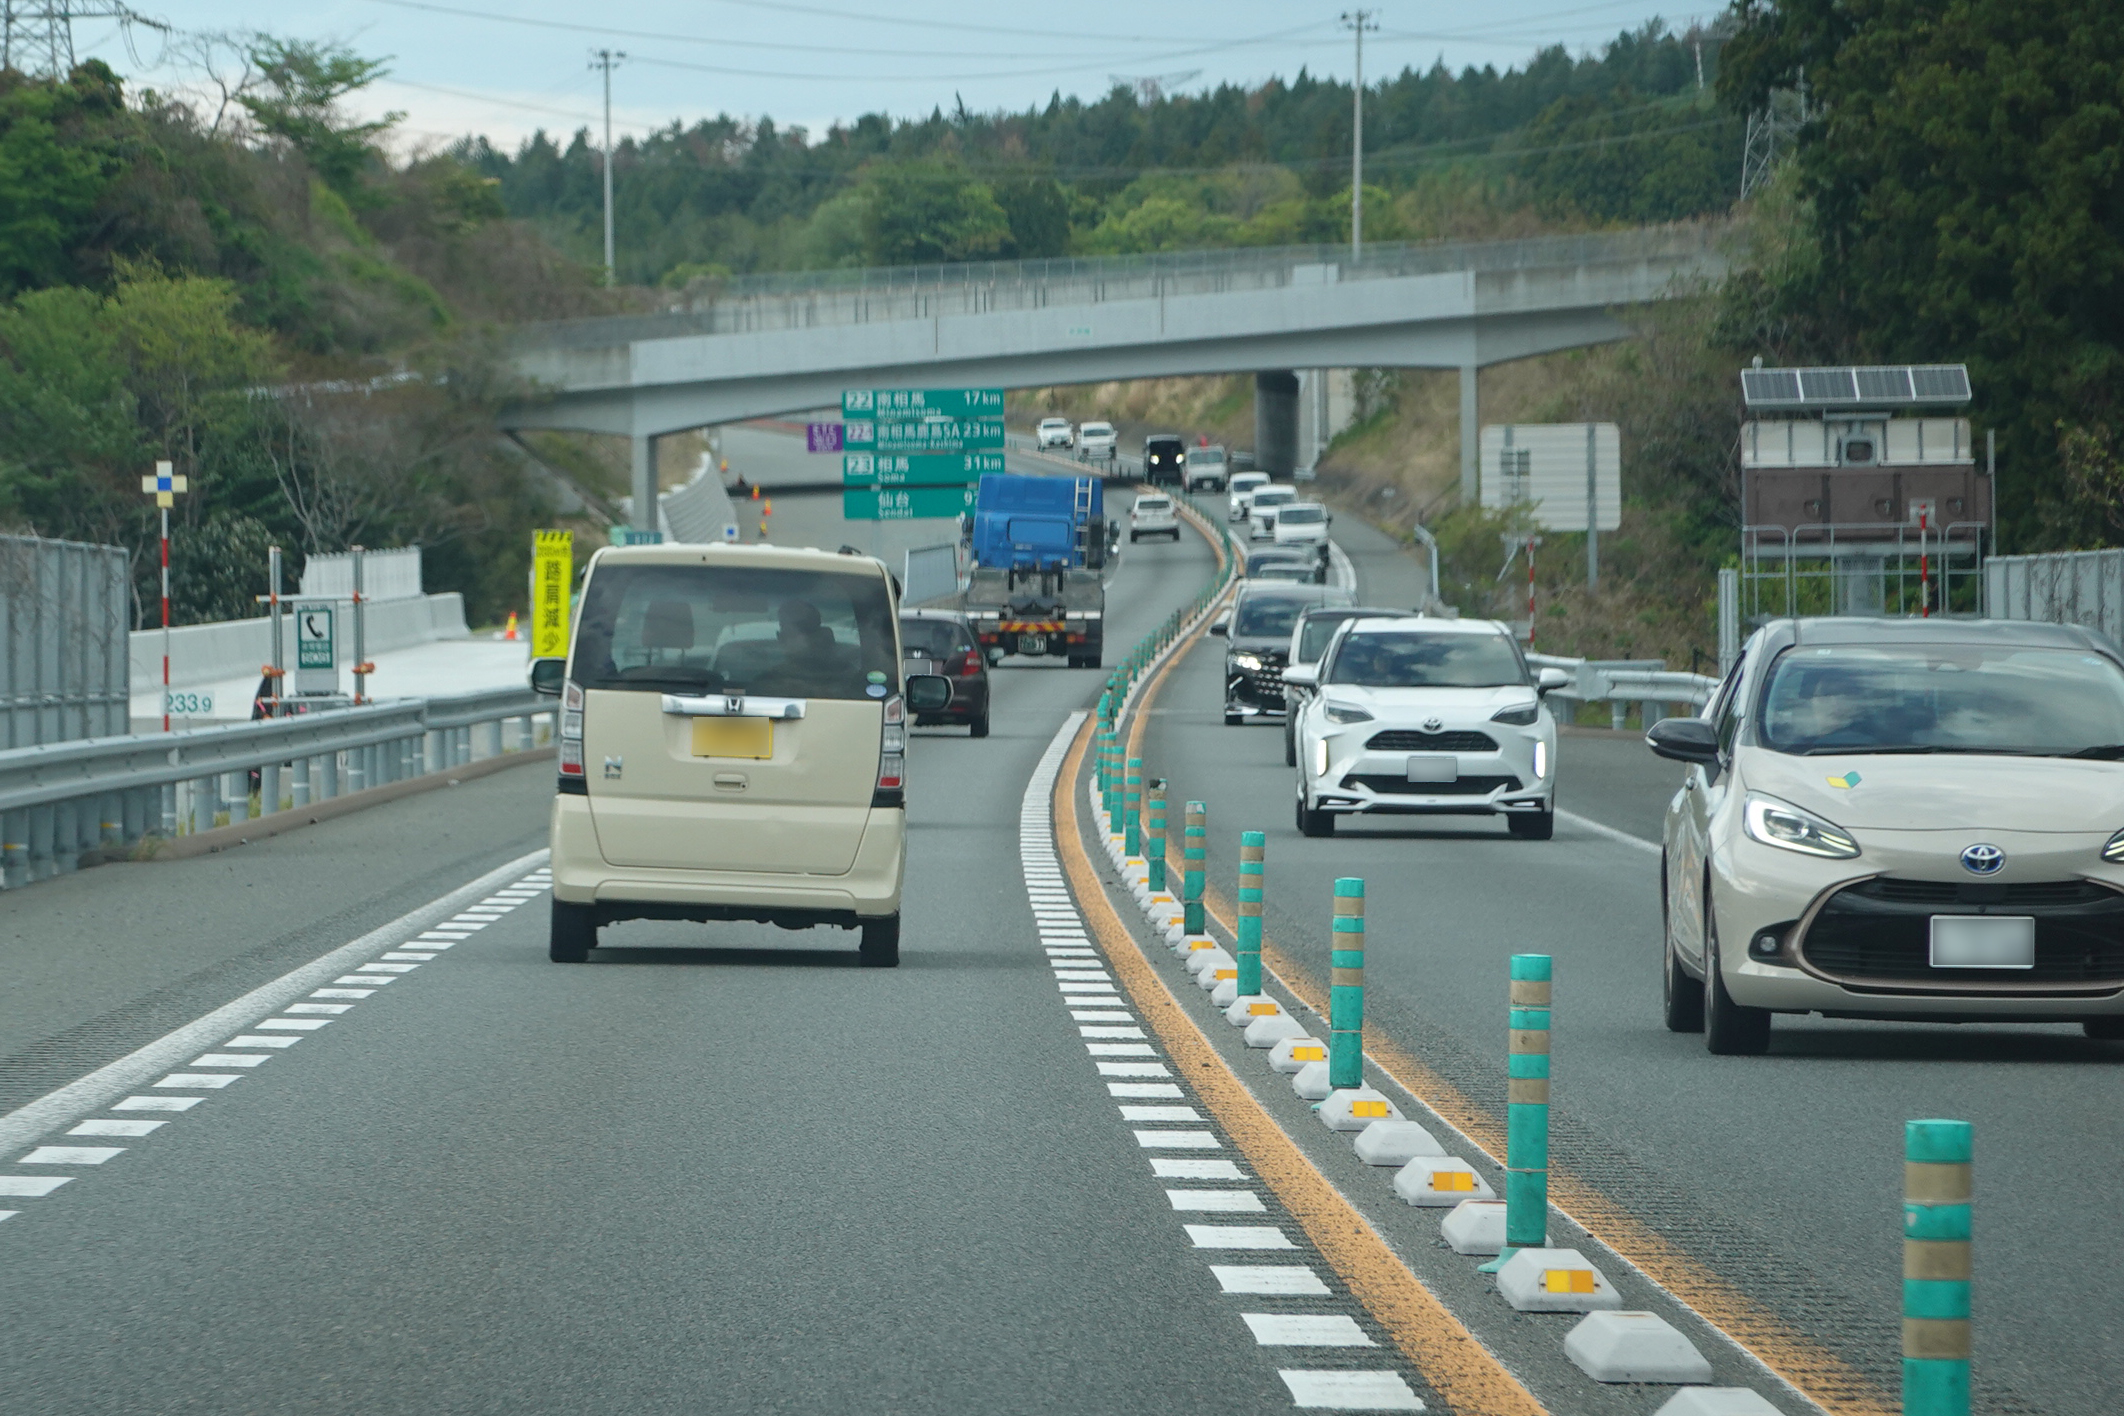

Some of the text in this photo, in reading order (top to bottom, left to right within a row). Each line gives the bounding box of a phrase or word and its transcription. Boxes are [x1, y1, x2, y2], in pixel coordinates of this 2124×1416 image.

[849, 391, 1000, 409] 22 南相馬 17 km
[963, 422, 980, 438] 23
[983, 423, 1000, 438] km
[878, 456, 909, 473] 相馬
[964, 455, 980, 471] 31
[984, 455, 1001, 470] km
[878, 491, 909, 508] 仙台
